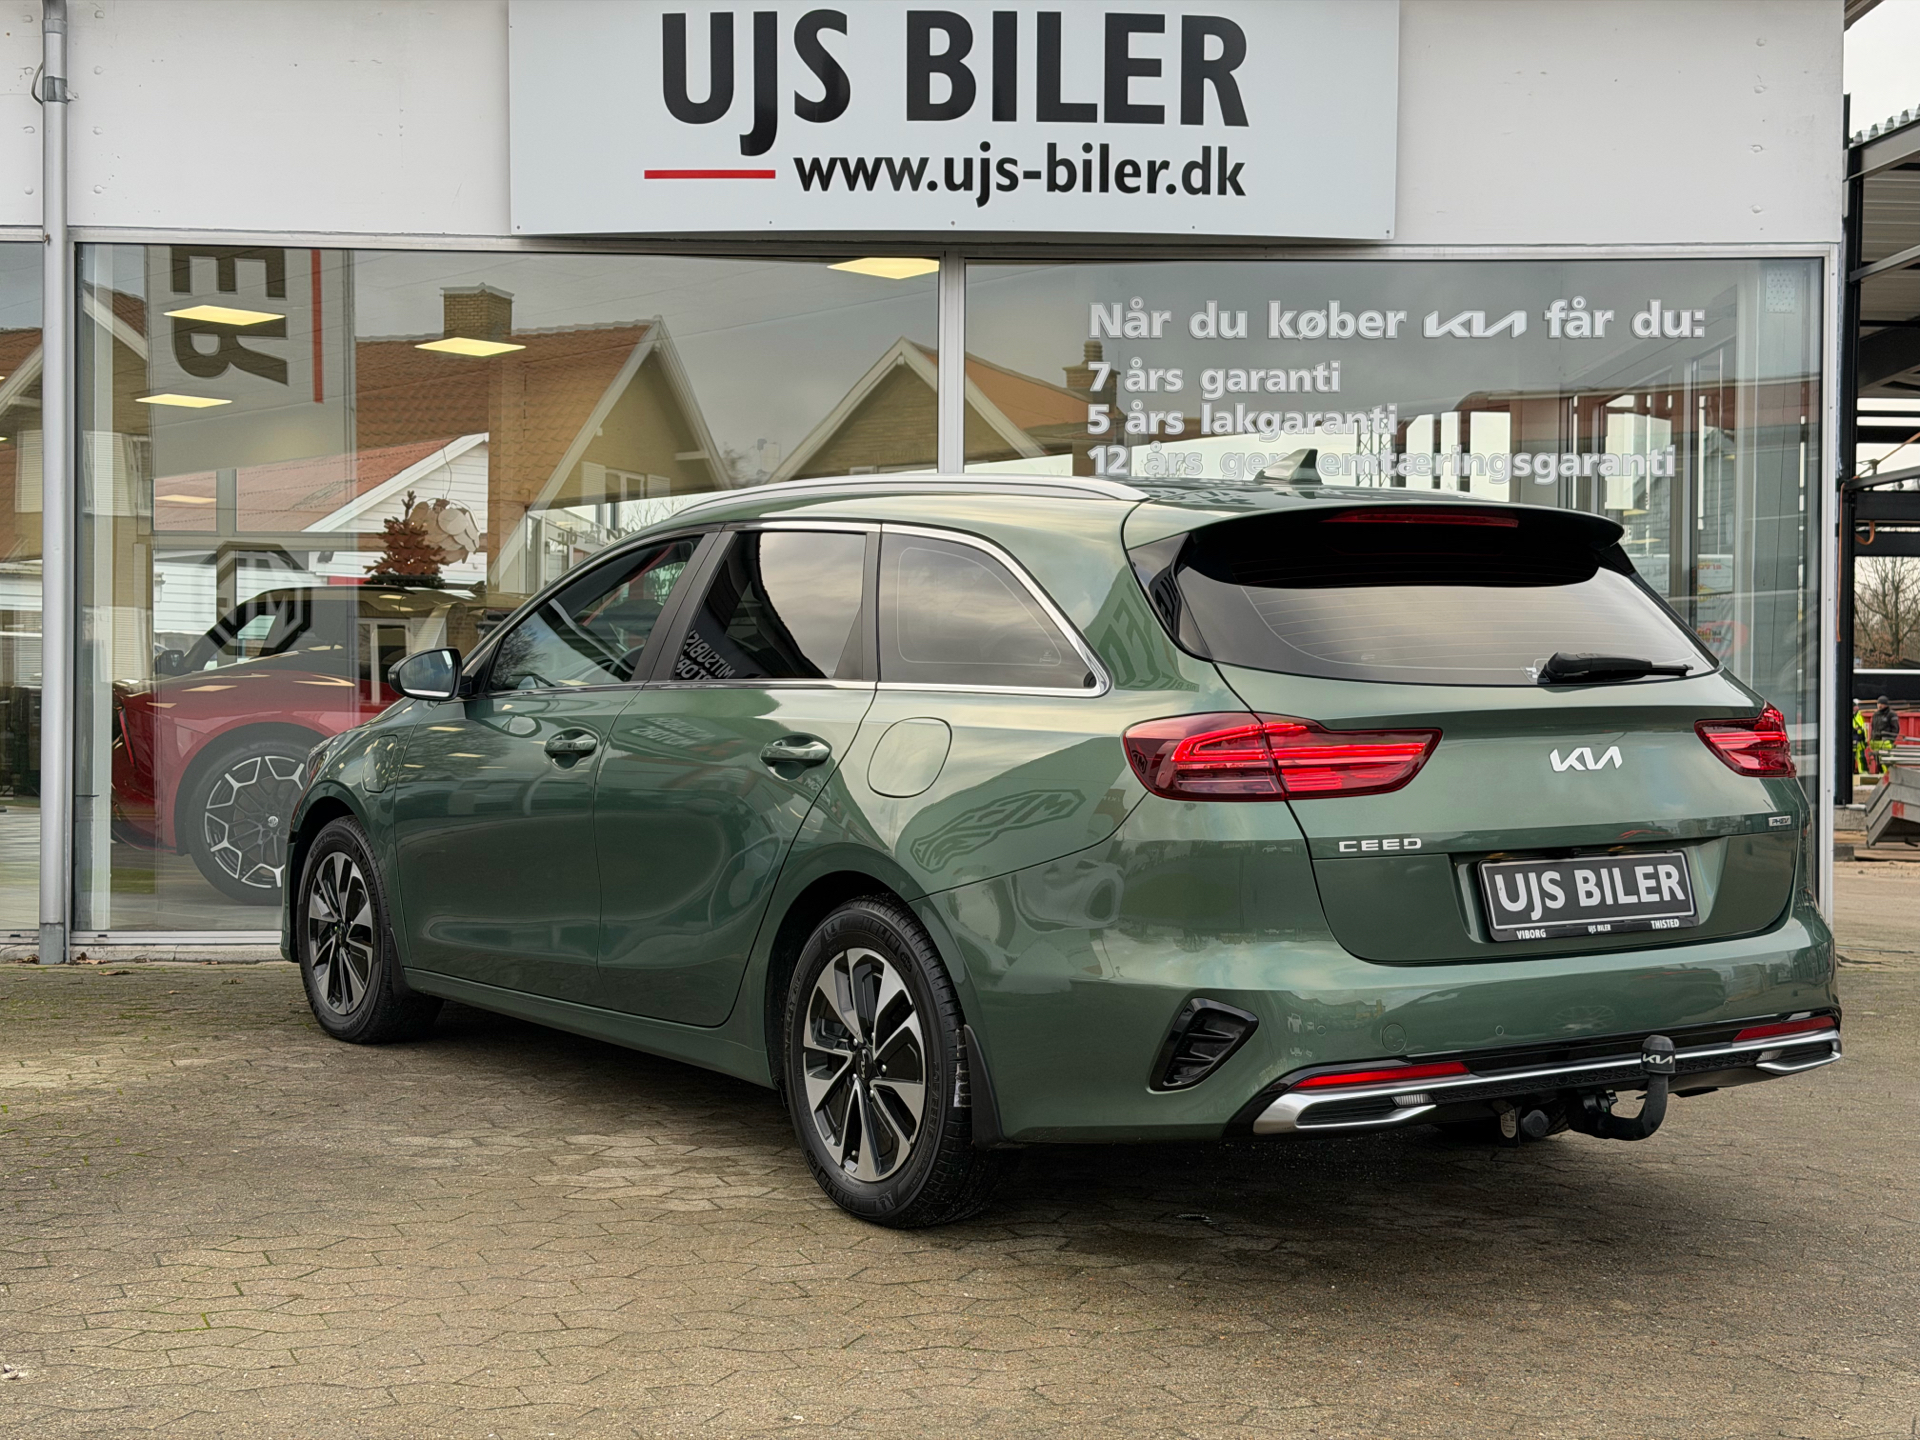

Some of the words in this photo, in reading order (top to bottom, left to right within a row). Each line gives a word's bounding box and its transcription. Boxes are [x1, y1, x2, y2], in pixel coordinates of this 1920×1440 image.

[662, 9, 851, 156] UJS
[906, 10, 1249, 127] BILER
[793, 141, 1247, 208] www.ujs-biler.dk
[1089, 296, 1171, 339] Når
[1189, 302, 1248, 339] du
[1267, 300, 1407, 339] køber
[1422, 309, 1527, 338] KIA
[1544, 296, 1614, 339] får
[1632, 299, 1706, 339] du:
[1087, 361, 1112, 393] 7
[1124, 357, 1184, 393] års
[1199, 359, 1341, 400] garanti
[1087, 404, 1111, 435] 5
[1124, 401, 1185, 435] års
[1201, 403, 1399, 442] lakgaranti
[1087, 445, 1129, 477] 12
[1144, 442, 1204, 477] års
[1219, 444, 1676, 485] geemtæringsgaranti
[1549, 746, 1623, 772] KIA
[1339, 838, 1422, 852] CEED
[1494, 871, 1566, 920] UJS
[1573, 864, 1686, 907] BILER
[1516, 929, 1547, 940] VIBORG
[1587, 925, 1597, 934] UJS
[1597, 924, 1611, 933] BILER
[1650, 919, 1680, 930] THISTED
[1642, 1053, 1673, 1065] KIA
